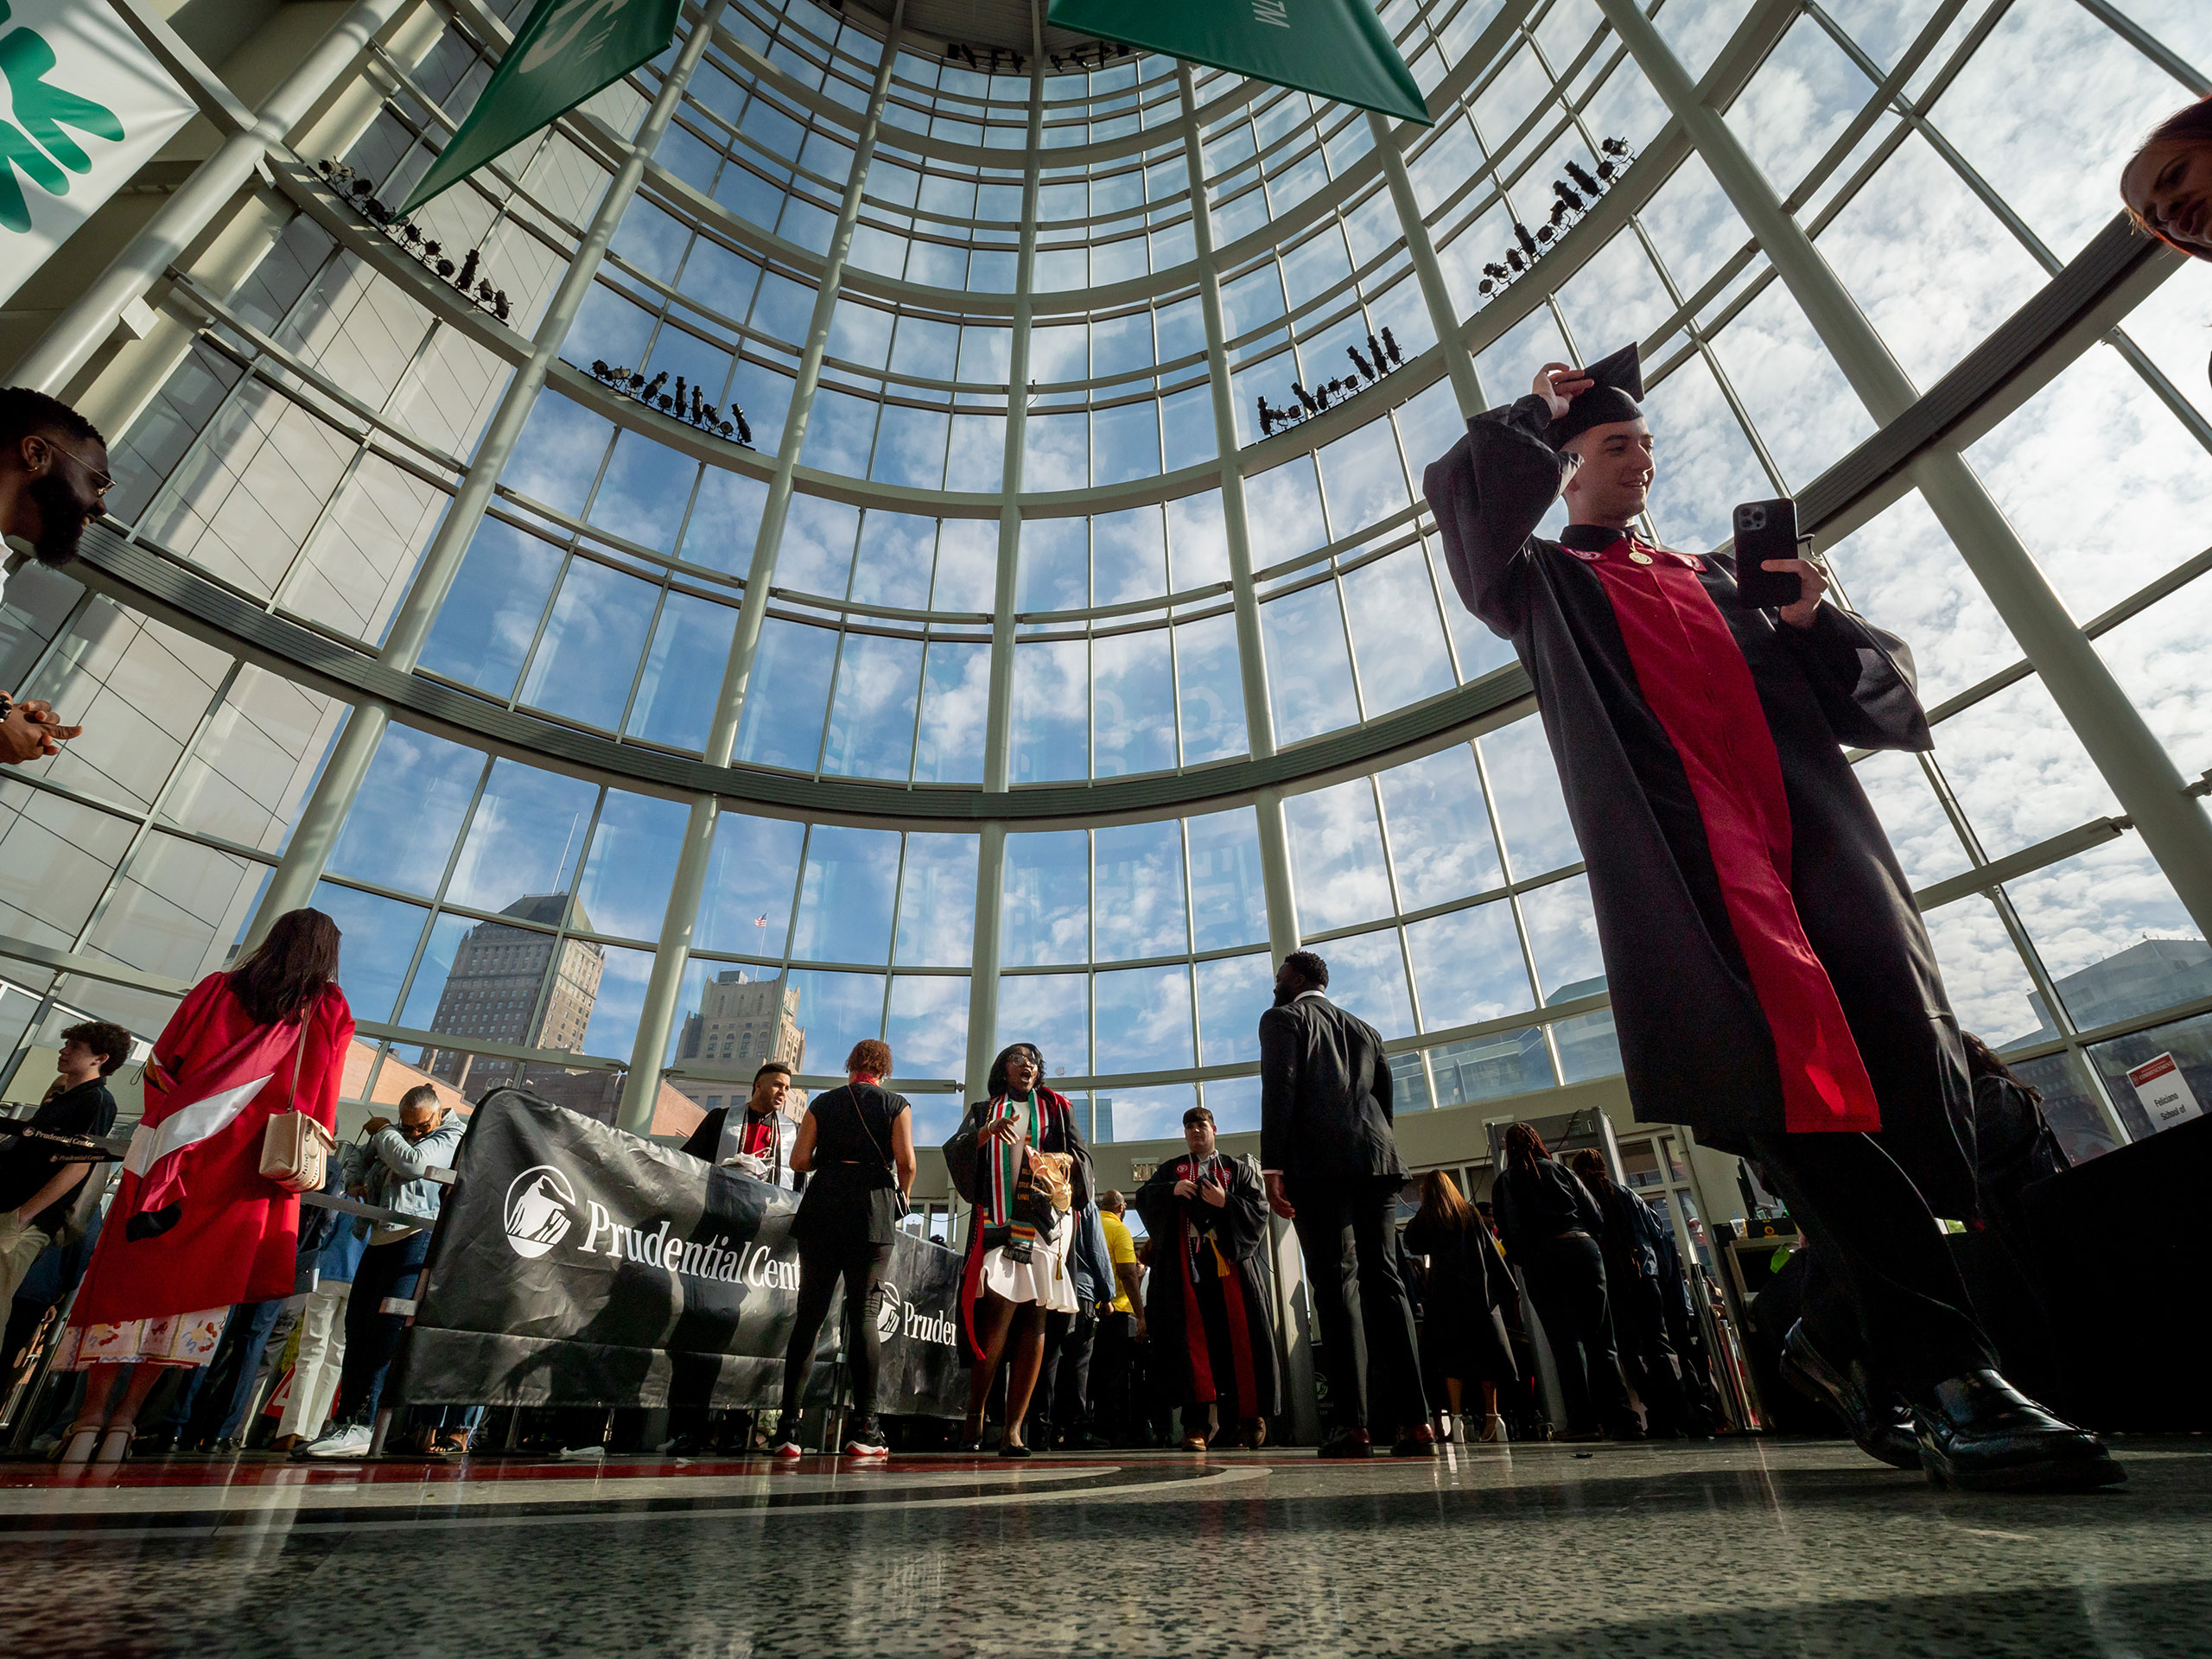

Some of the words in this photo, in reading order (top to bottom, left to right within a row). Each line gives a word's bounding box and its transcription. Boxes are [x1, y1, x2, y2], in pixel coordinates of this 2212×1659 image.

[2154, 1093, 2179, 1108] Feliciano
[2160, 1107, 2180, 1121] School
[2179, 1104, 2186, 1114] of
[35, 1130, 73, 1144] Prudential
[72, 1138, 96, 1148] Center
[578, 1200, 752, 1285] Prudential
[747, 1245, 801, 1292] Cent
[903, 1300, 957, 1346] Prude
